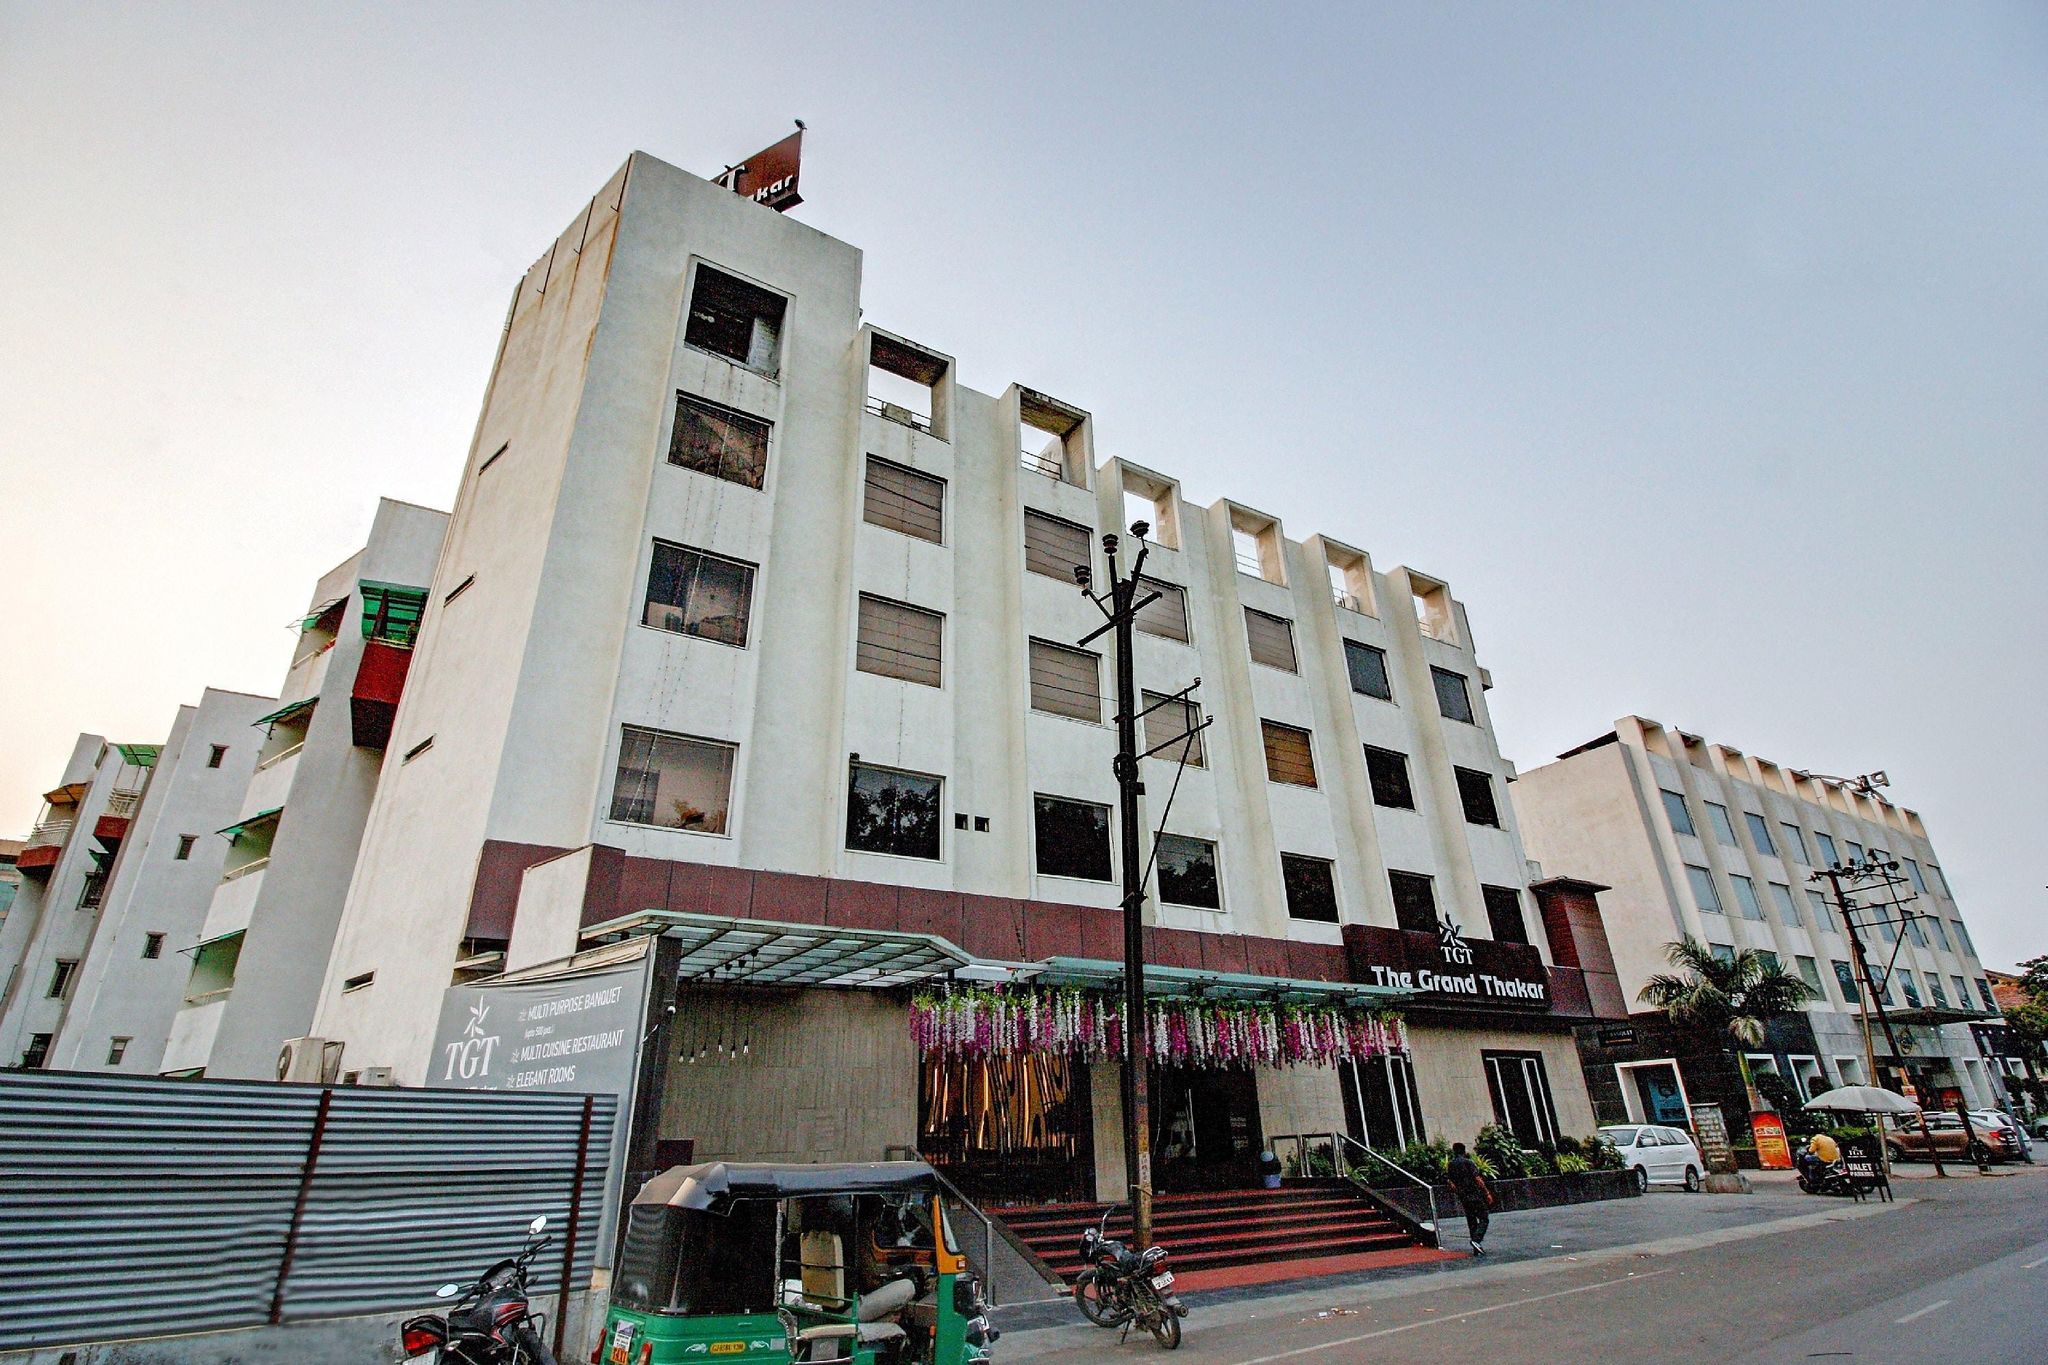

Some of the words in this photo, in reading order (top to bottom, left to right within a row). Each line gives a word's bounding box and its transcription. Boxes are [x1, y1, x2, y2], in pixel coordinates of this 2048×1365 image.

[1440, 946, 1473, 965] TGT
[1371, 966, 1413, 988] The
[1418, 969, 1477, 994] Grand
[1479, 974, 1544, 999] Thakar
[527, 1003, 550, 1020] MULTI
[549, 995, 584, 1017] PURPOSE
[584, 986, 622, 1010] BANQUET
[444, 1035, 500, 1081] TGT
[520, 1044, 543, 1061] MULTI
[541, 1039, 573, 1059] CUISINE
[572, 1029, 624, 1054] RESTAURANT
[516, 1068, 548, 1088] ELEGANT
[548, 1065, 576, 1085] ROOMS
[1847, 1162, 1872, 1171] VALET
